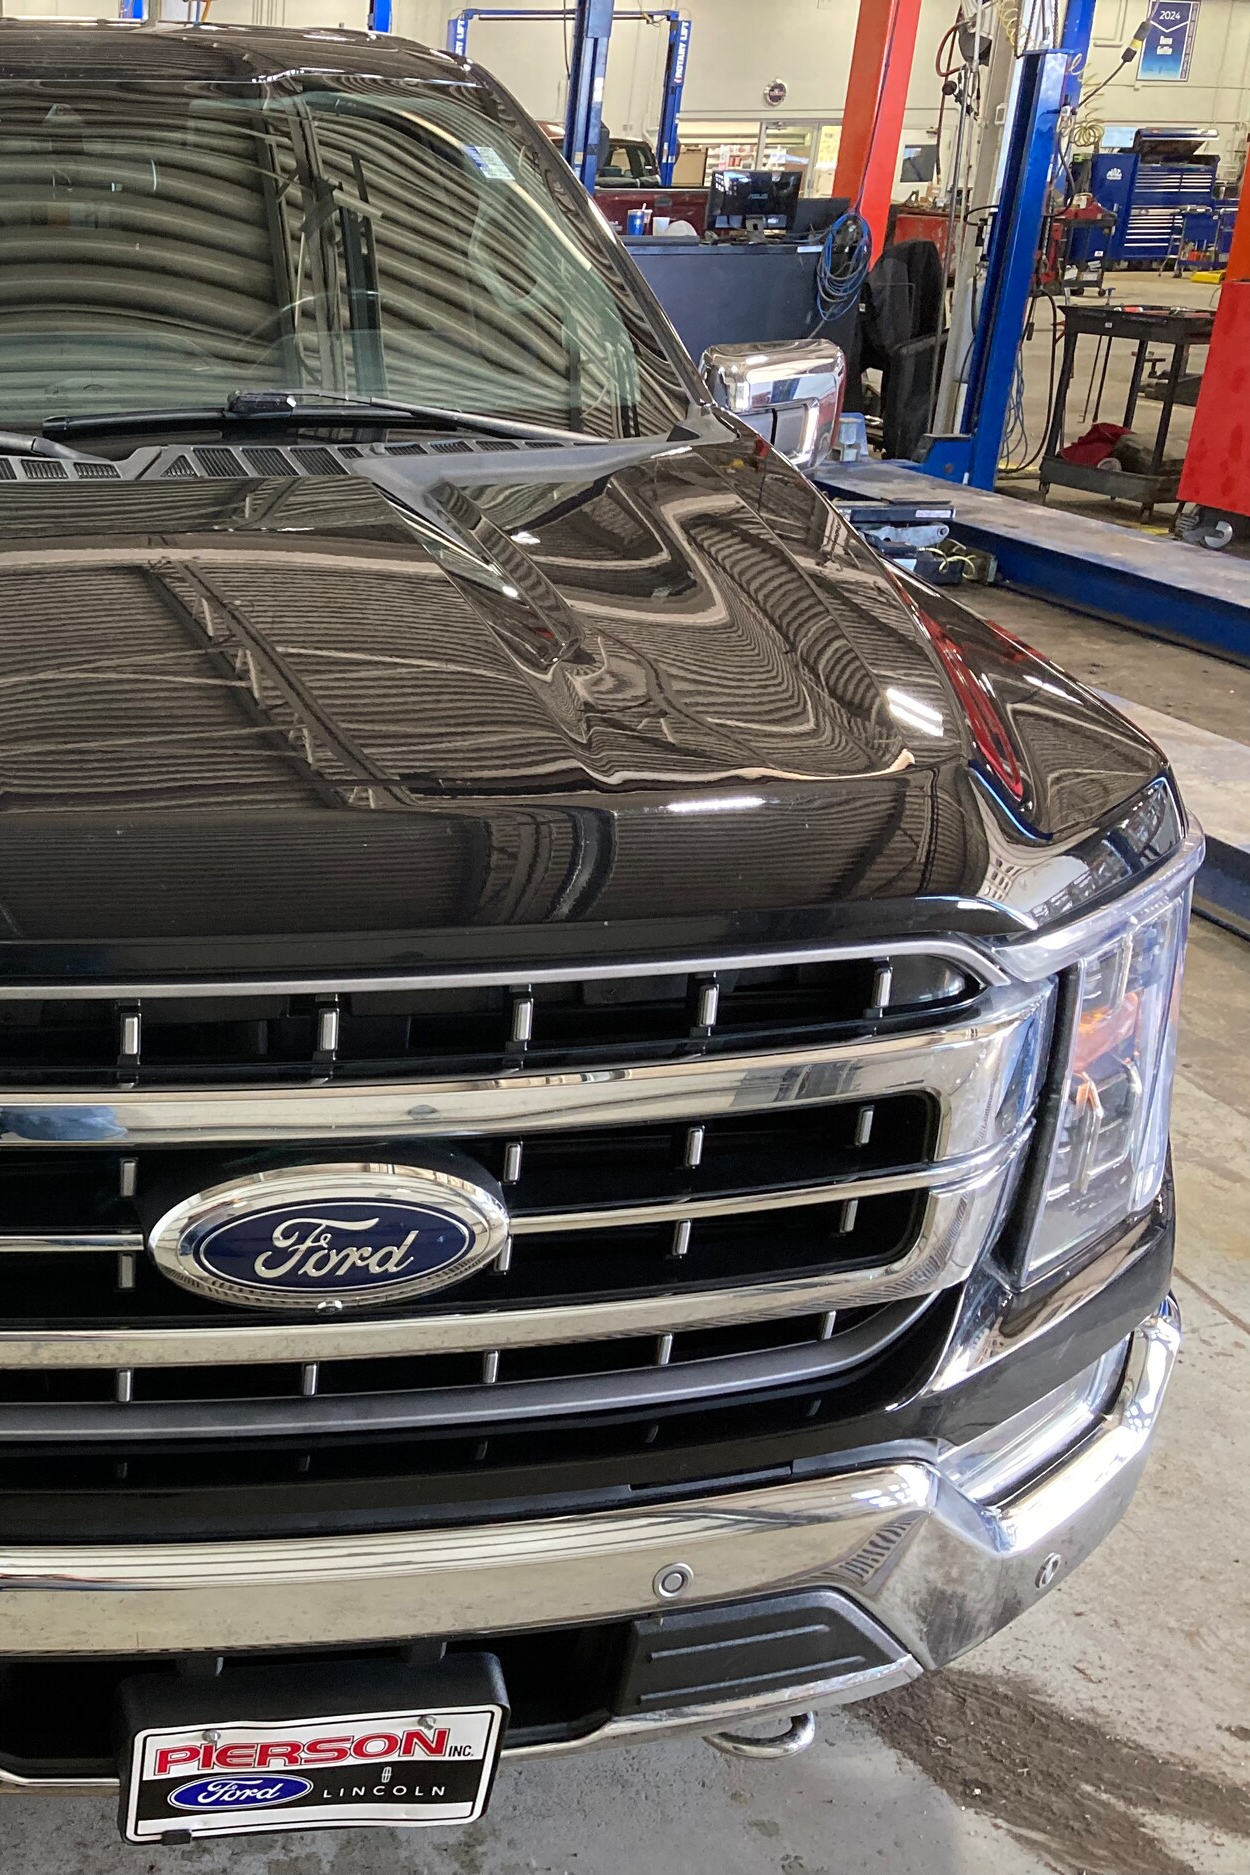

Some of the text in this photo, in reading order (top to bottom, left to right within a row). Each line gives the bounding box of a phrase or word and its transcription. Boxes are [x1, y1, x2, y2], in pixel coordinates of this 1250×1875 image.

[1159, 11, 1181, 20] 2024
[456, 19, 465, 39] LIFT
[680, 21, 689, 41] LIFT
[254, 1216, 419, 1278] Ford
[153, 1727, 474, 1776] PIERSON INC.
[197, 1778, 281, 1806] Ford
[323, 1785, 446, 1799] LINCOLN
